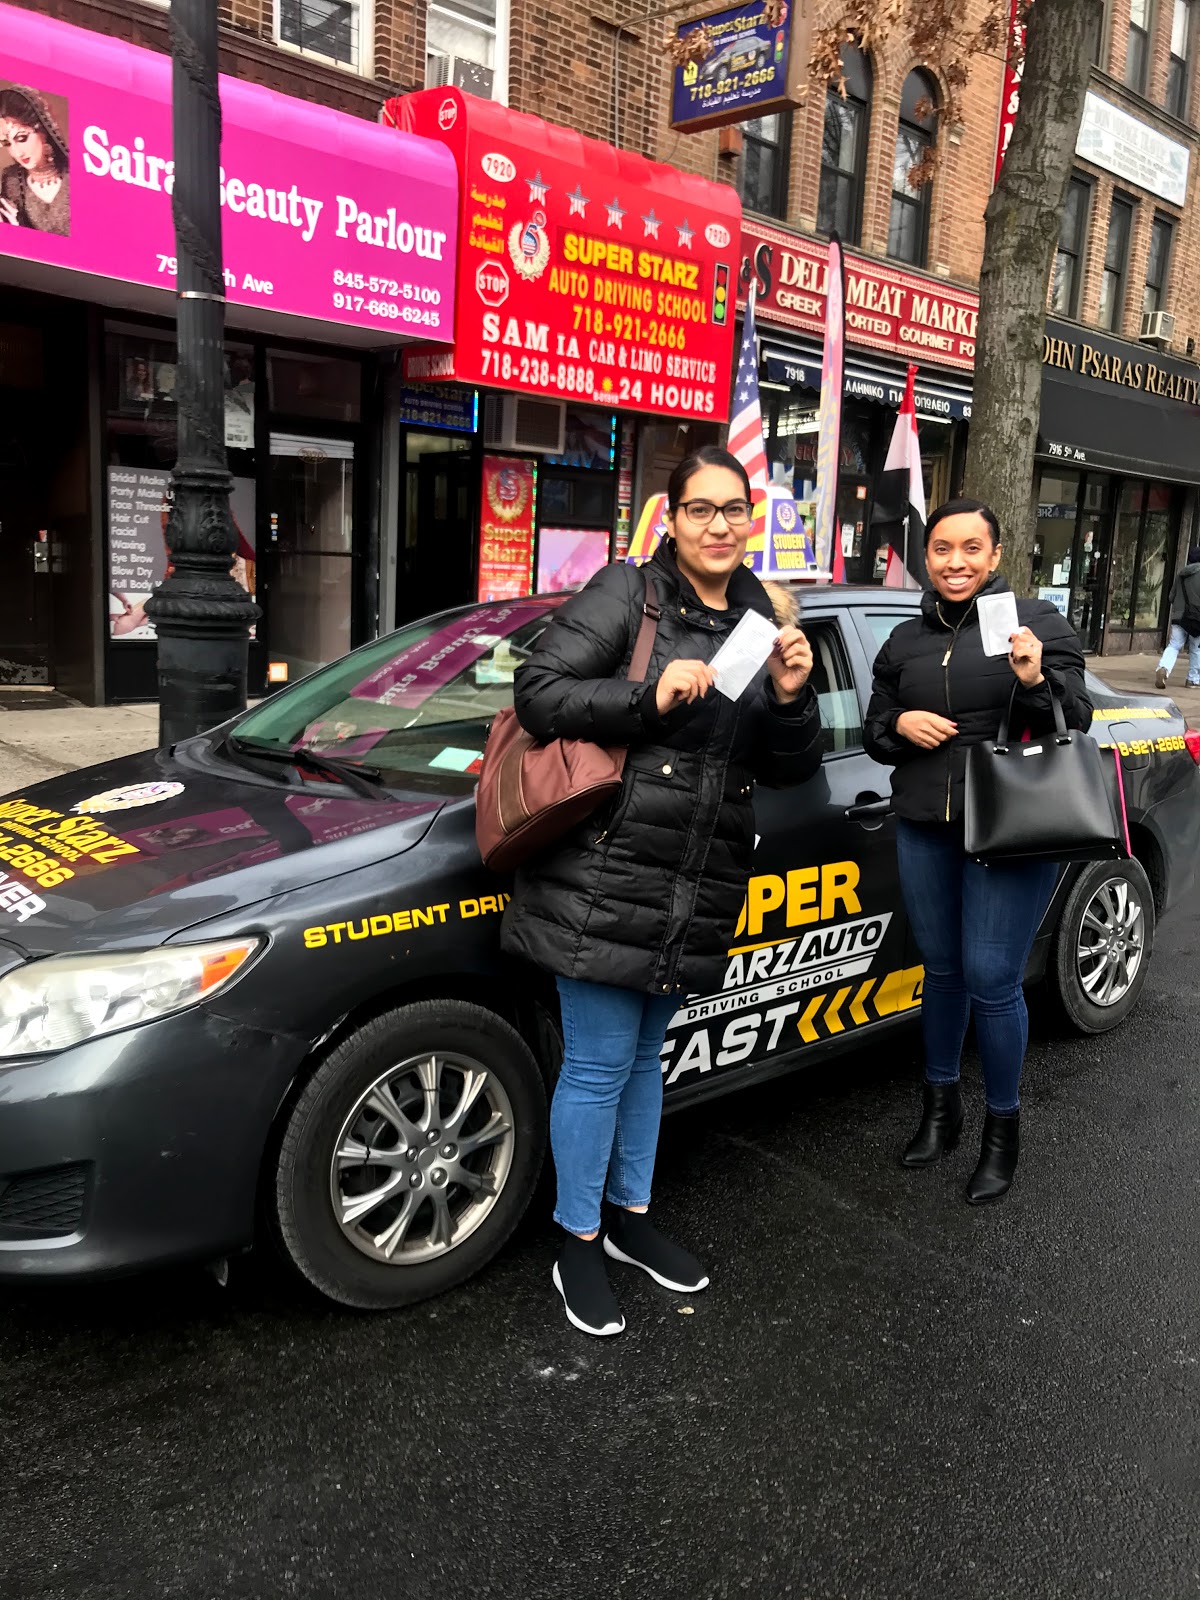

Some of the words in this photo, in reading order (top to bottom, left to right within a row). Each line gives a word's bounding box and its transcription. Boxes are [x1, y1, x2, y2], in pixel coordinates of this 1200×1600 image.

[690, 66, 776, 101] 718-921-2666
[440, 109, 455, 121] STOP
[487, 157, 512, 179] 7920
[83, 125, 175, 195] Saira
[336, 195, 446, 261] Parlour
[708, 227, 728, 245] 7920
[563, 233, 634, 275] SUPER
[637, 251, 699, 290] STARZ
[242, 273, 274, 295] Ave
[333, 270, 440, 305] 845-572-5100
[479, 275, 506, 293] STOP
[754, 243, 773, 300] S
[846, 275, 907, 319] MEAT
[548, 267, 589, 299] AUTO
[594, 277, 653, 313] DRIVING
[657, 291, 707, 324] SCHOOL
[333, 292, 440, 328] 917-669-6245
[776, 290, 822, 317] GREEK
[899, 325, 955, 352] GOURMET
[572, 305, 686, 350] 718-921-2666
[482, 312, 550, 353] SAM
[588, 337, 616, 365] CAR
[618, 350, 628, 368] &
[630, 346, 662, 374] LIMO
[665, 353, 717, 384] SERVICE
[480, 349, 595, 394] 718-238-8888
[784, 366, 805, 383] 7918
[1080, 343, 1143, 389] PSARAS
[619, 376, 643, 402] 24
[650, 381, 714, 413] HOURS
[843, 380, 884, 399] ΛΛΗΝΙΚΟ
[1049, 443, 1062, 456] 7916
[110, 472, 137, 484] Bridal
[139, 474, 166, 486] Make
[110, 486, 134, 499] Party
[137, 488, 163, 499] Make
[110, 499, 132, 510] Face
[111, 513, 131, 523] Hair
[133, 514, 149, 524] Cut
[111, 526, 137, 537] Facial
[483, 523, 529, 546] Super
[773, 533, 805, 550] STUDENT
[111, 540, 146, 553] Waxing
[482, 543, 528, 562] Starz
[111, 553, 128, 565] Eye
[130, 553, 154, 563] Brow
[775, 551, 806, 570] DRIVER
[111, 566, 134, 576] Blow
[136, 566, 153, 579] Dry
[111, 579, 127, 589] Full
[130, 580, 153, 592] Body
[34, 835, 83, 863] SCHOOL
[38, 816, 140, 864] Starz
[733, 860, 862, 939] PER
[303, 903, 450, 949] STUDENT
[800, 920, 883, 963] AUTO
[687, 992, 760, 1021] DRIVING
[776, 967, 844, 996] SCHOOL
